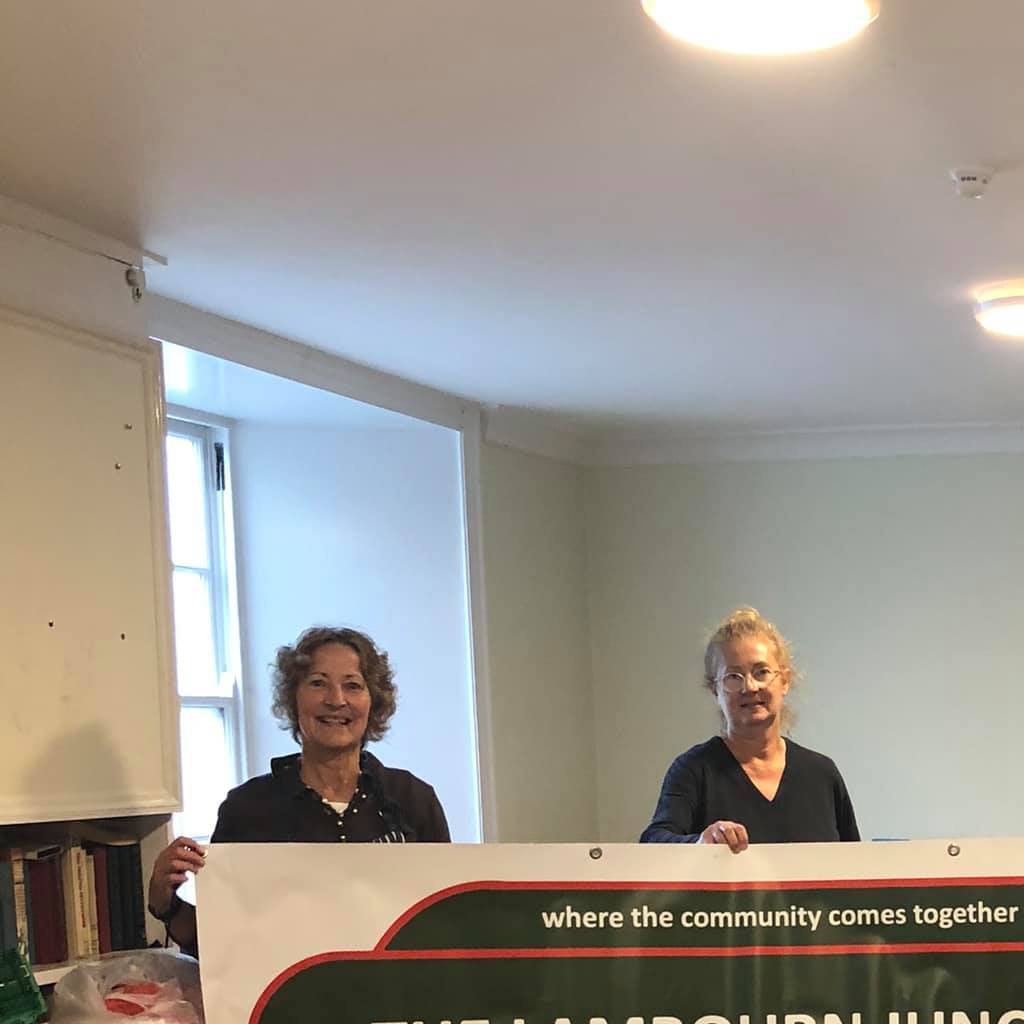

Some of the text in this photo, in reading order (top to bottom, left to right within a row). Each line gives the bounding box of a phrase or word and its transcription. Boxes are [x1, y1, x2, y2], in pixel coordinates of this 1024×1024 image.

[541, 900, 1019, 932] where the community comes together
